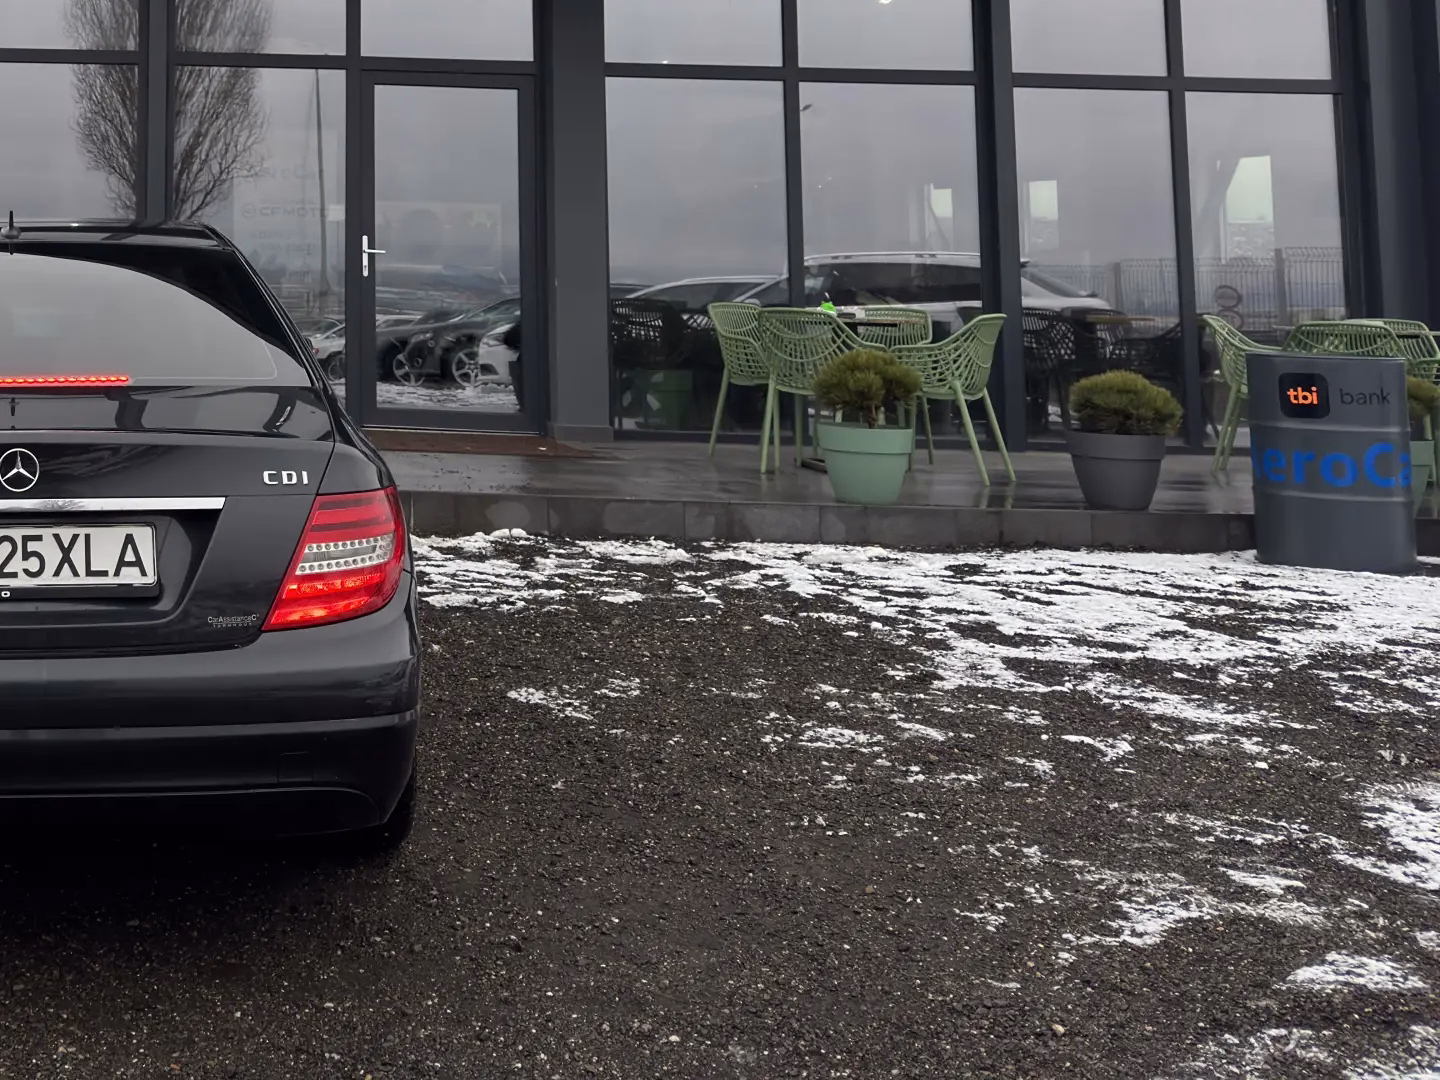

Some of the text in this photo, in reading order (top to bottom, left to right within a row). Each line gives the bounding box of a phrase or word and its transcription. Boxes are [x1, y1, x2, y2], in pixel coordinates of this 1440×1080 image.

[1287, 386, 1392, 405] tbi bank
[263, 470, 309, 485] CDI
